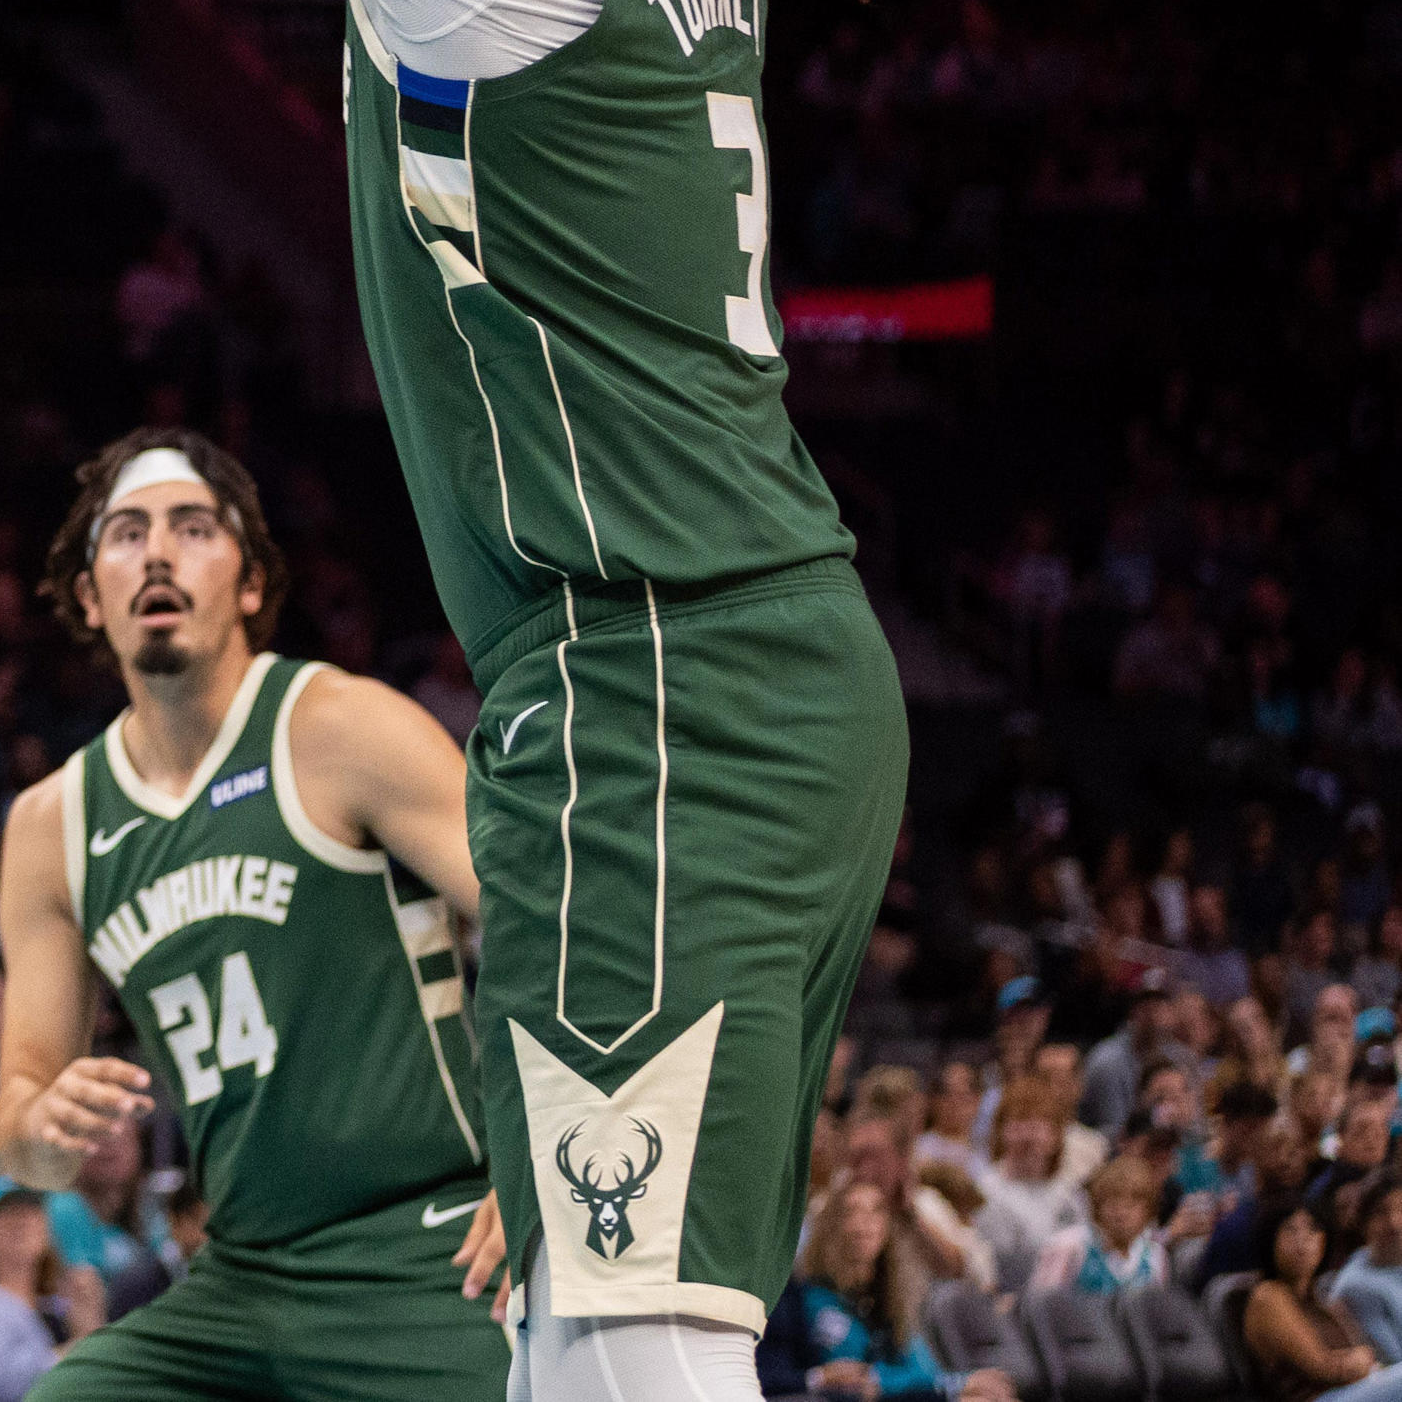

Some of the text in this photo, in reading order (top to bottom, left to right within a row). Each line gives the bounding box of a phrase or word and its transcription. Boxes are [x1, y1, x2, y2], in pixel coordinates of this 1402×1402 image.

[705, 90, 781, 358] 3
[88, 854, 298, 988] MILWAUKEE
[147, 950, 278, 1107] 24
